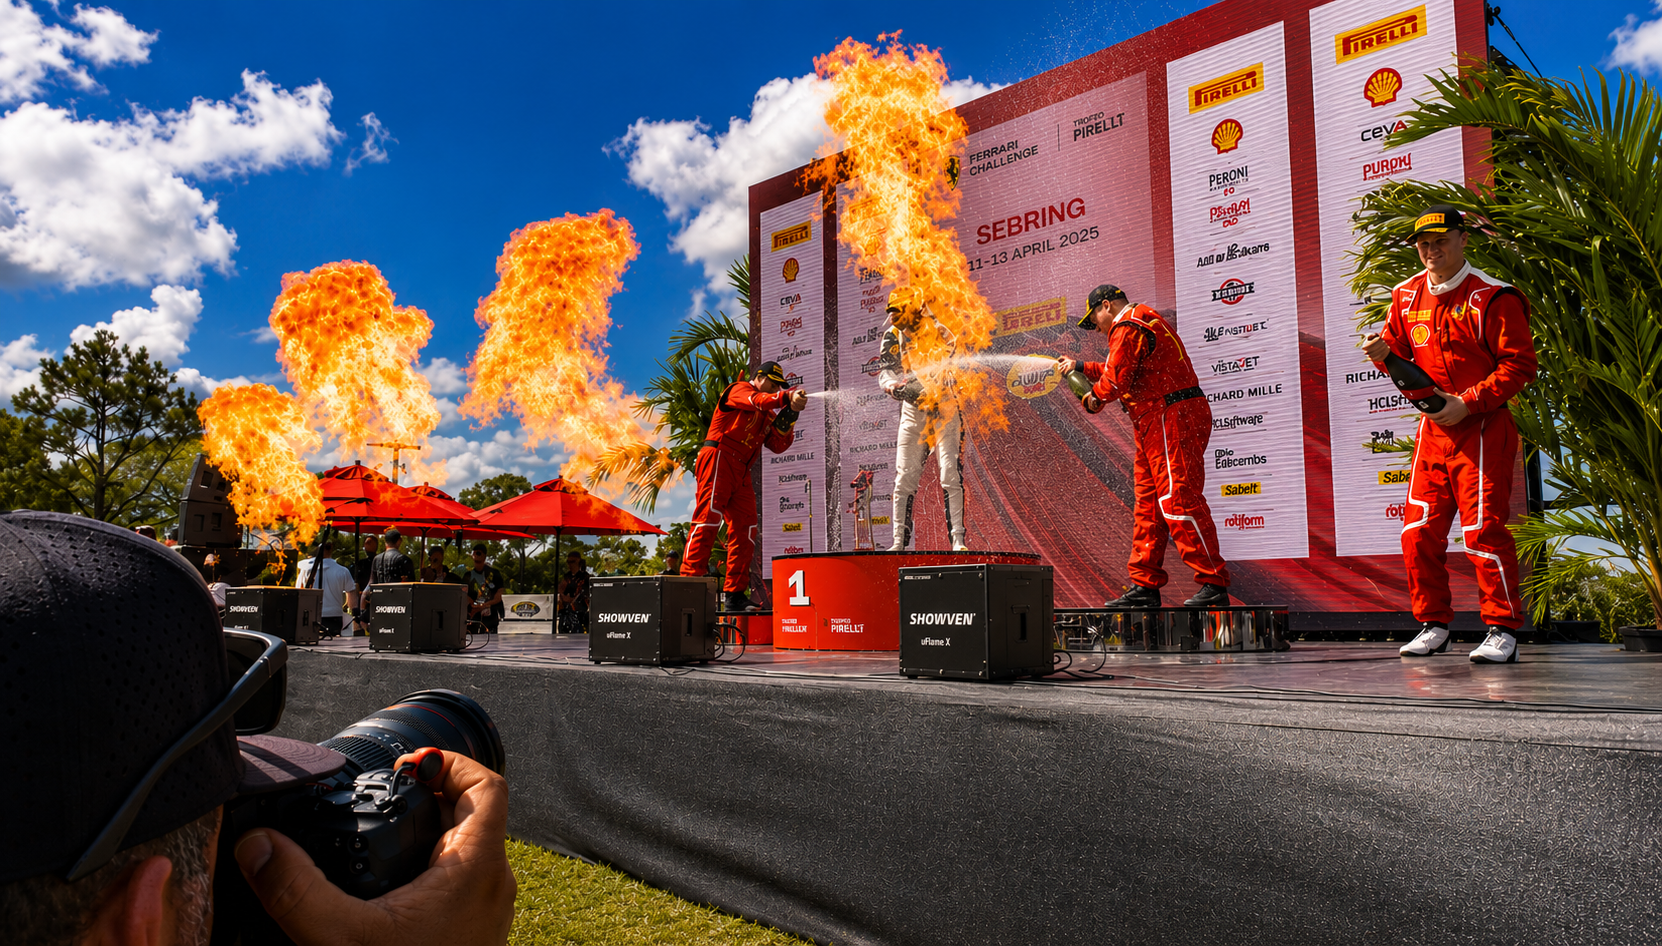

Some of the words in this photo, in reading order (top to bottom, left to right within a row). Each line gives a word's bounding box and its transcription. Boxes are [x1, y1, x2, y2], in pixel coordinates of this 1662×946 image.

[1342, 14, 1418, 57] PIRELLI
[1194, 70, 1257, 107] PIRELLI
[969, 140, 1018, 165] FERRARI
[969, 145, 1039, 176] CHALLENGE
[1209, 165, 1248, 187] PERONI
[977, 197, 1086, 245] SEBRING
[967, 251, 1008, 272] 11-13
[1011, 239, 1055, 261] APRIL
[1059, 226, 1100, 249] 2025
[1346, 370, 1390, 384] RICHA
[1207, 390, 1244, 402] CHARD
[1248, 384, 1282, 397] MILLE
[1225, 483, 1258, 495] Sabelt
[788, 570, 810, 606] 1
[598, 613, 649, 623] SHOWVEN
[909, 612, 973, 625] SHOWVEN
[945, 637, 951, 646] X
